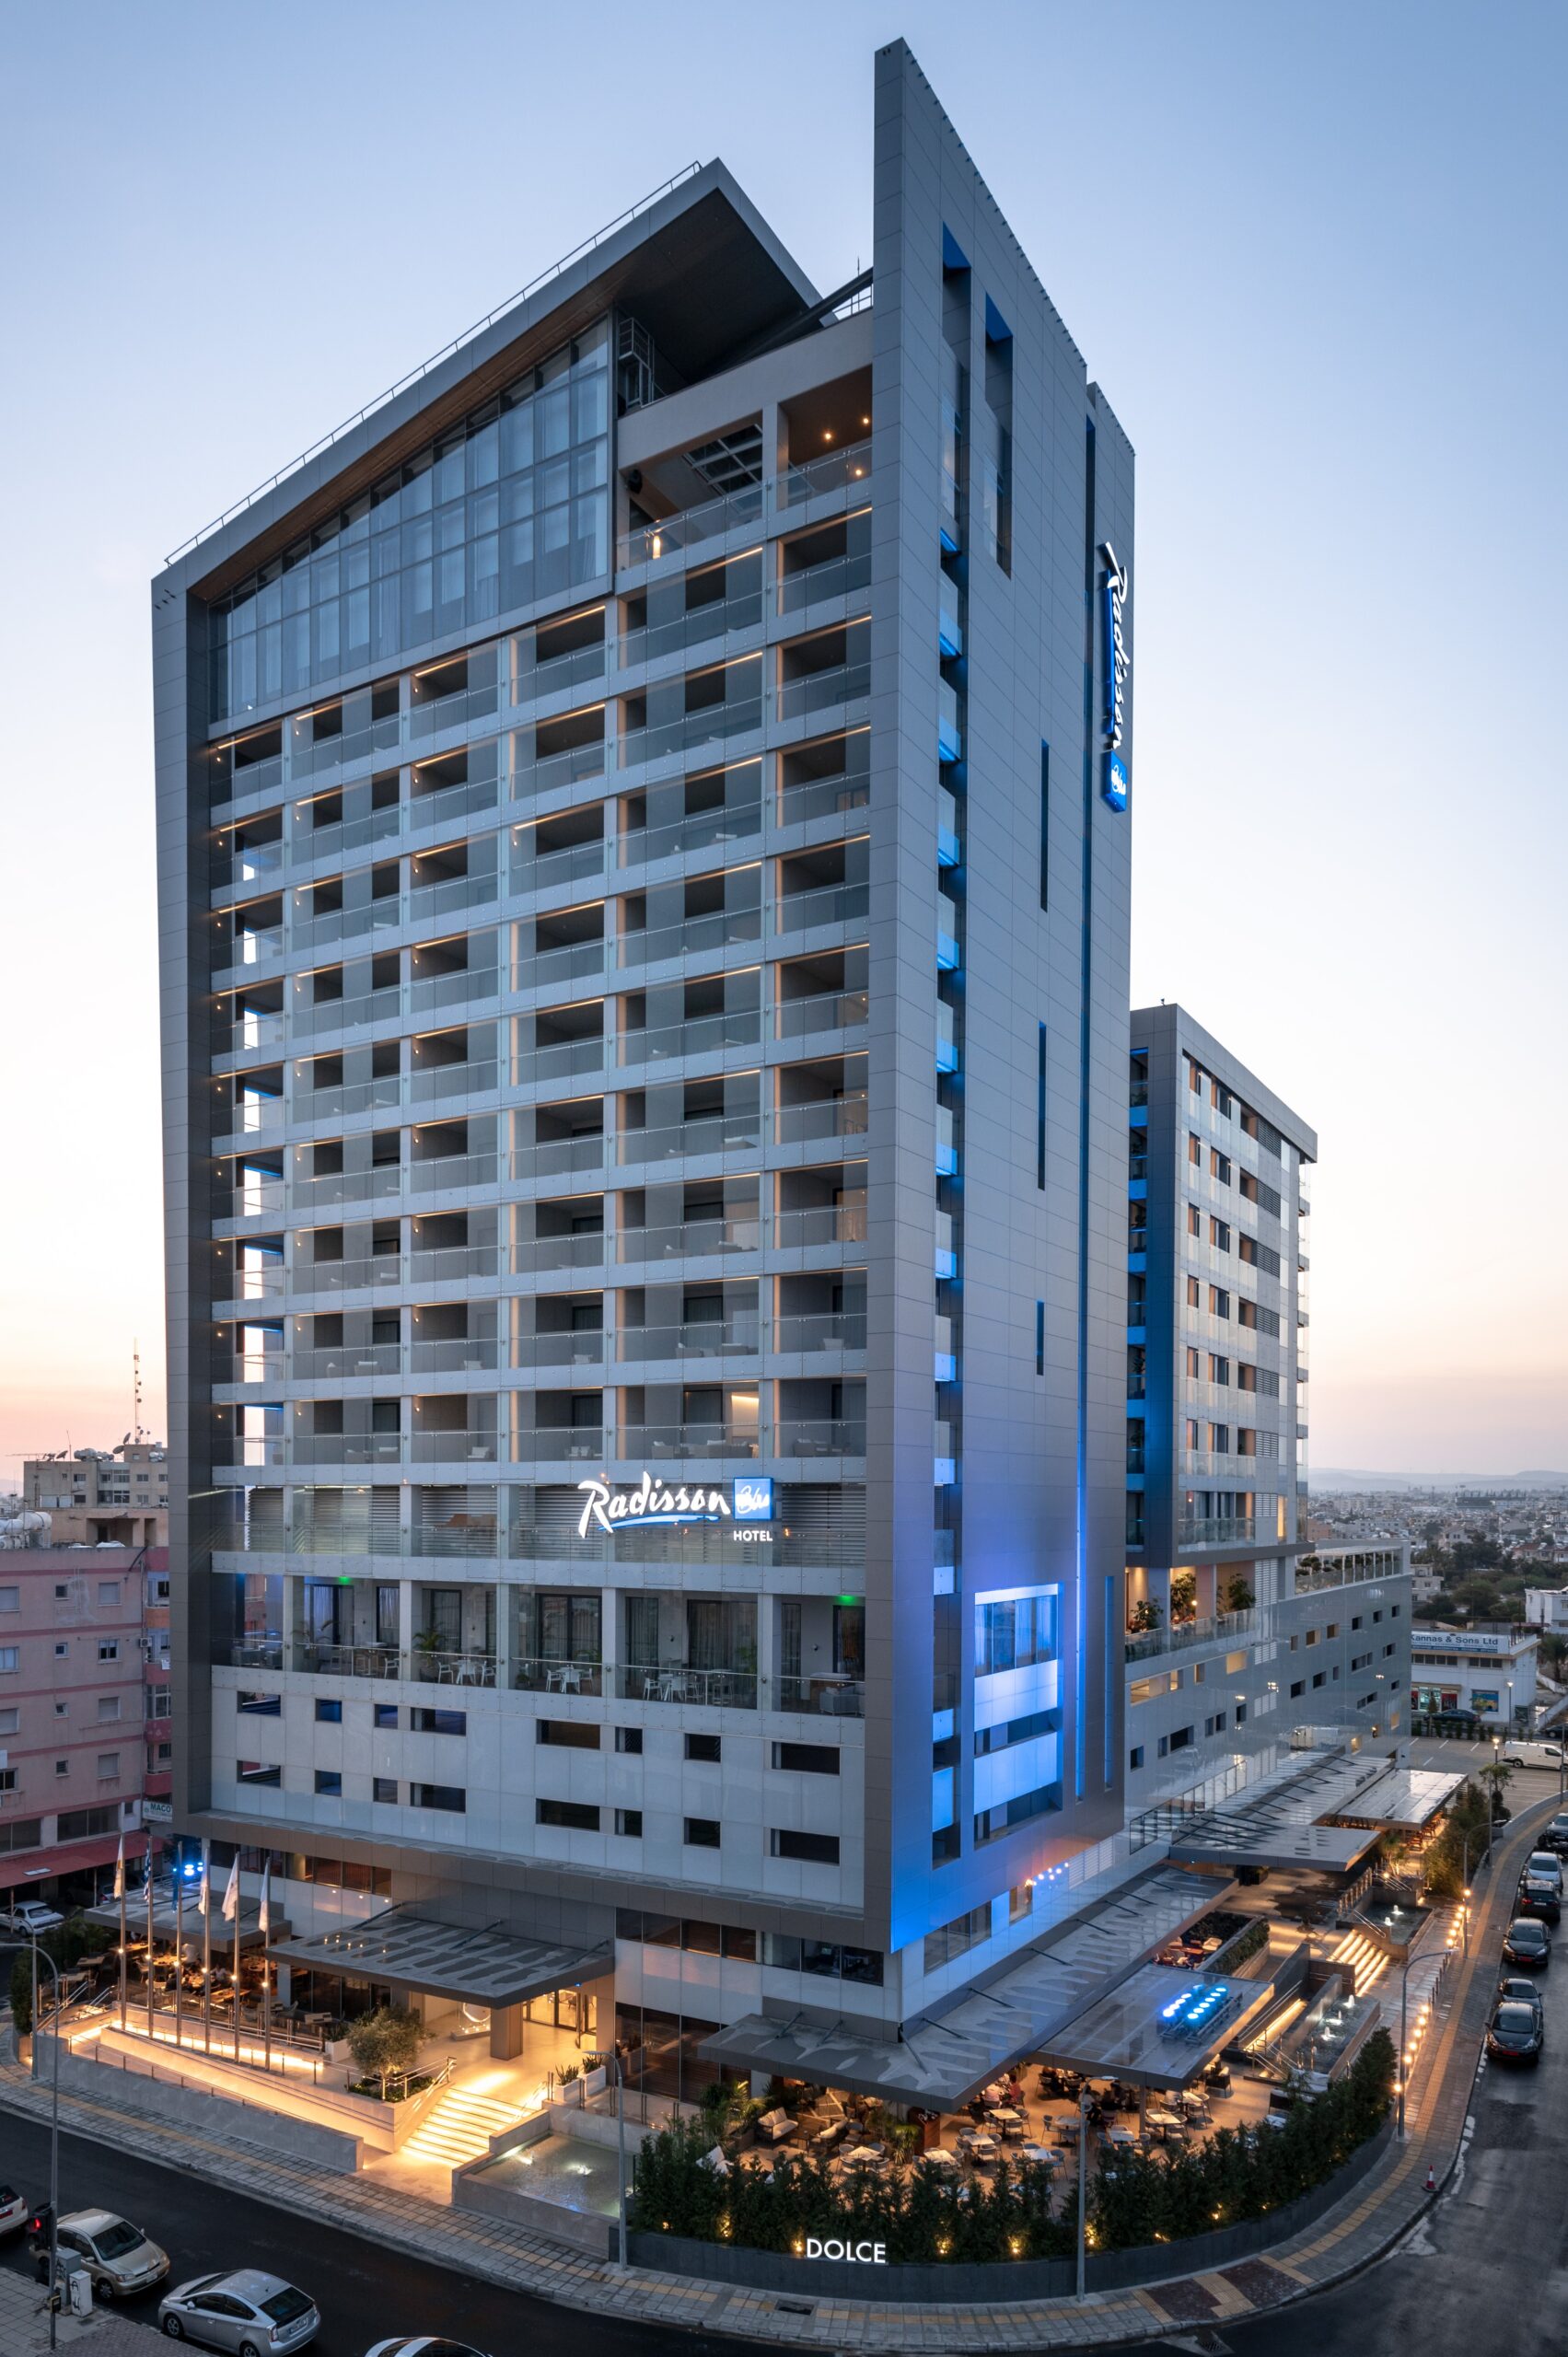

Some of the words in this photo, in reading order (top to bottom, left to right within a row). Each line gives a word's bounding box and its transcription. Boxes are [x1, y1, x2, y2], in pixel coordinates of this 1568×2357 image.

[1106, 541, 1130, 749] Radisson
[578, 1471, 731, 1539] Radisson
[736, 1485, 770, 1515] Blu
[733, 1530, 773, 1542] HOTEL
[807, 2238, 886, 2263] DOLCE
